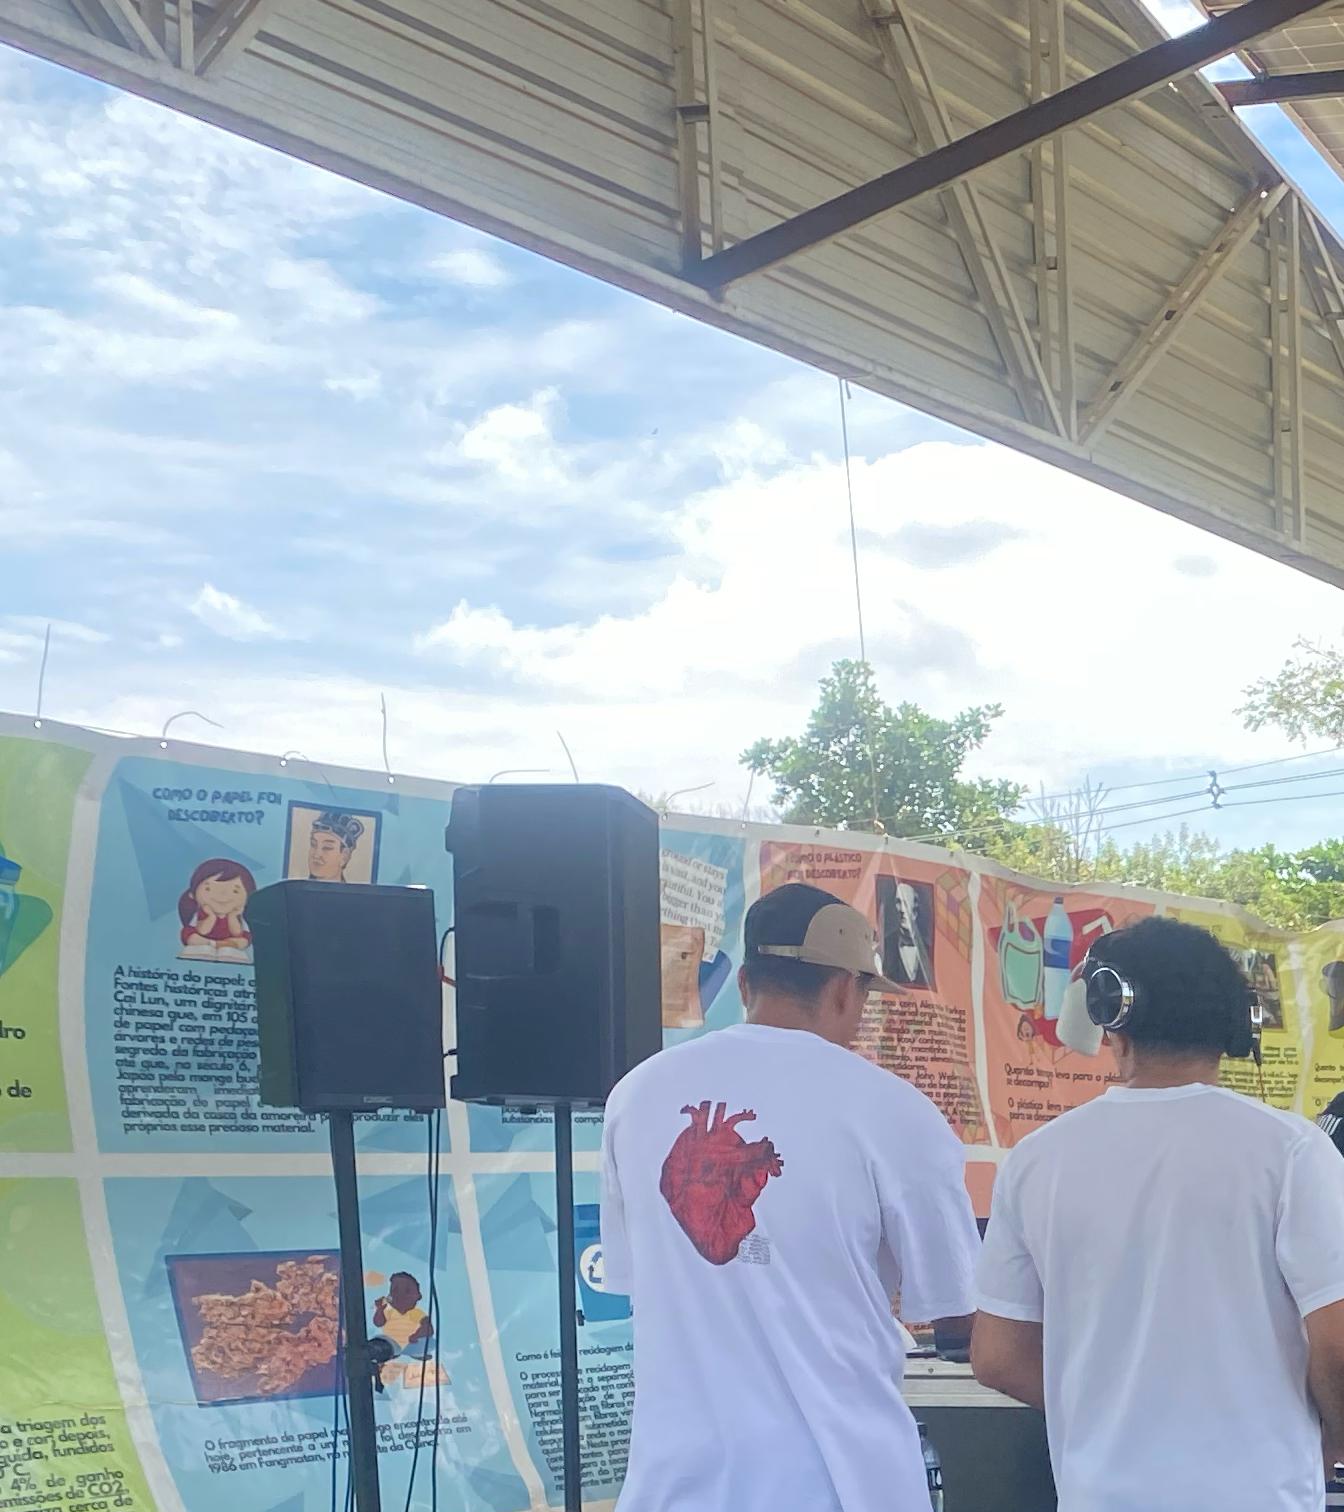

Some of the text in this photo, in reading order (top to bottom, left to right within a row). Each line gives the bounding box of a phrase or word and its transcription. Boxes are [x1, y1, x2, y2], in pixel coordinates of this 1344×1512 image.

[152, 787, 282, 805] COMO O PAPEL FOI
[167, 808, 265, 825] DESCOBERTO?
[114, 965, 124, 977] A
[128, 966, 178, 981] história
[183, 970, 201, 983] do
[114, 978, 228, 998] Fontes históricas
[113, 990, 257, 1013] Cai Lun, um dignitári
[114, 1003, 248, 1023] chinesa que, em 105
[114, 1017, 257, 1037] de papel com pedaço
[115, 1044, 168, 1058] segredo
[172, 1046, 189, 1057] da
[170, 1035, 177, 1044] e
[181, 1034, 215, 1046] redes
[218, 1036, 233, 1047] de
[237, 1039, 259, 1050] pes
[175, 1061, 191, 1070] no
[7, 1079, 33, 1098] de
[183, 1108, 200, 1119] da
[241, 1109, 257, 1120] da
[515, 1351, 542, 1362] Como
[519, 1371, 528, 1381] O
[1, 1412, 106, 1434] a triagem dos
[13, 1438, 23, 1447] e
[204, 1440, 216, 1451] O
[218, 1435, 278, 1451] fragmento
[281, 1430, 295, 1443] de
[297, 1426, 328, 1442] papel
[308, 1443, 316, 1451] a
[53, 1440, 115, 1458] fundidos
[208, 1458, 238, 1474] 1986
[239, 1461, 257, 1471] em
[389, 1442, 405, 1453] da
[10, 1467, 124, 1491] 4% de ganho
[0, 1490, 63, 1508] missões
[65, 1485, 85, 1500] de
[113, 1494, 133, 1508] de
